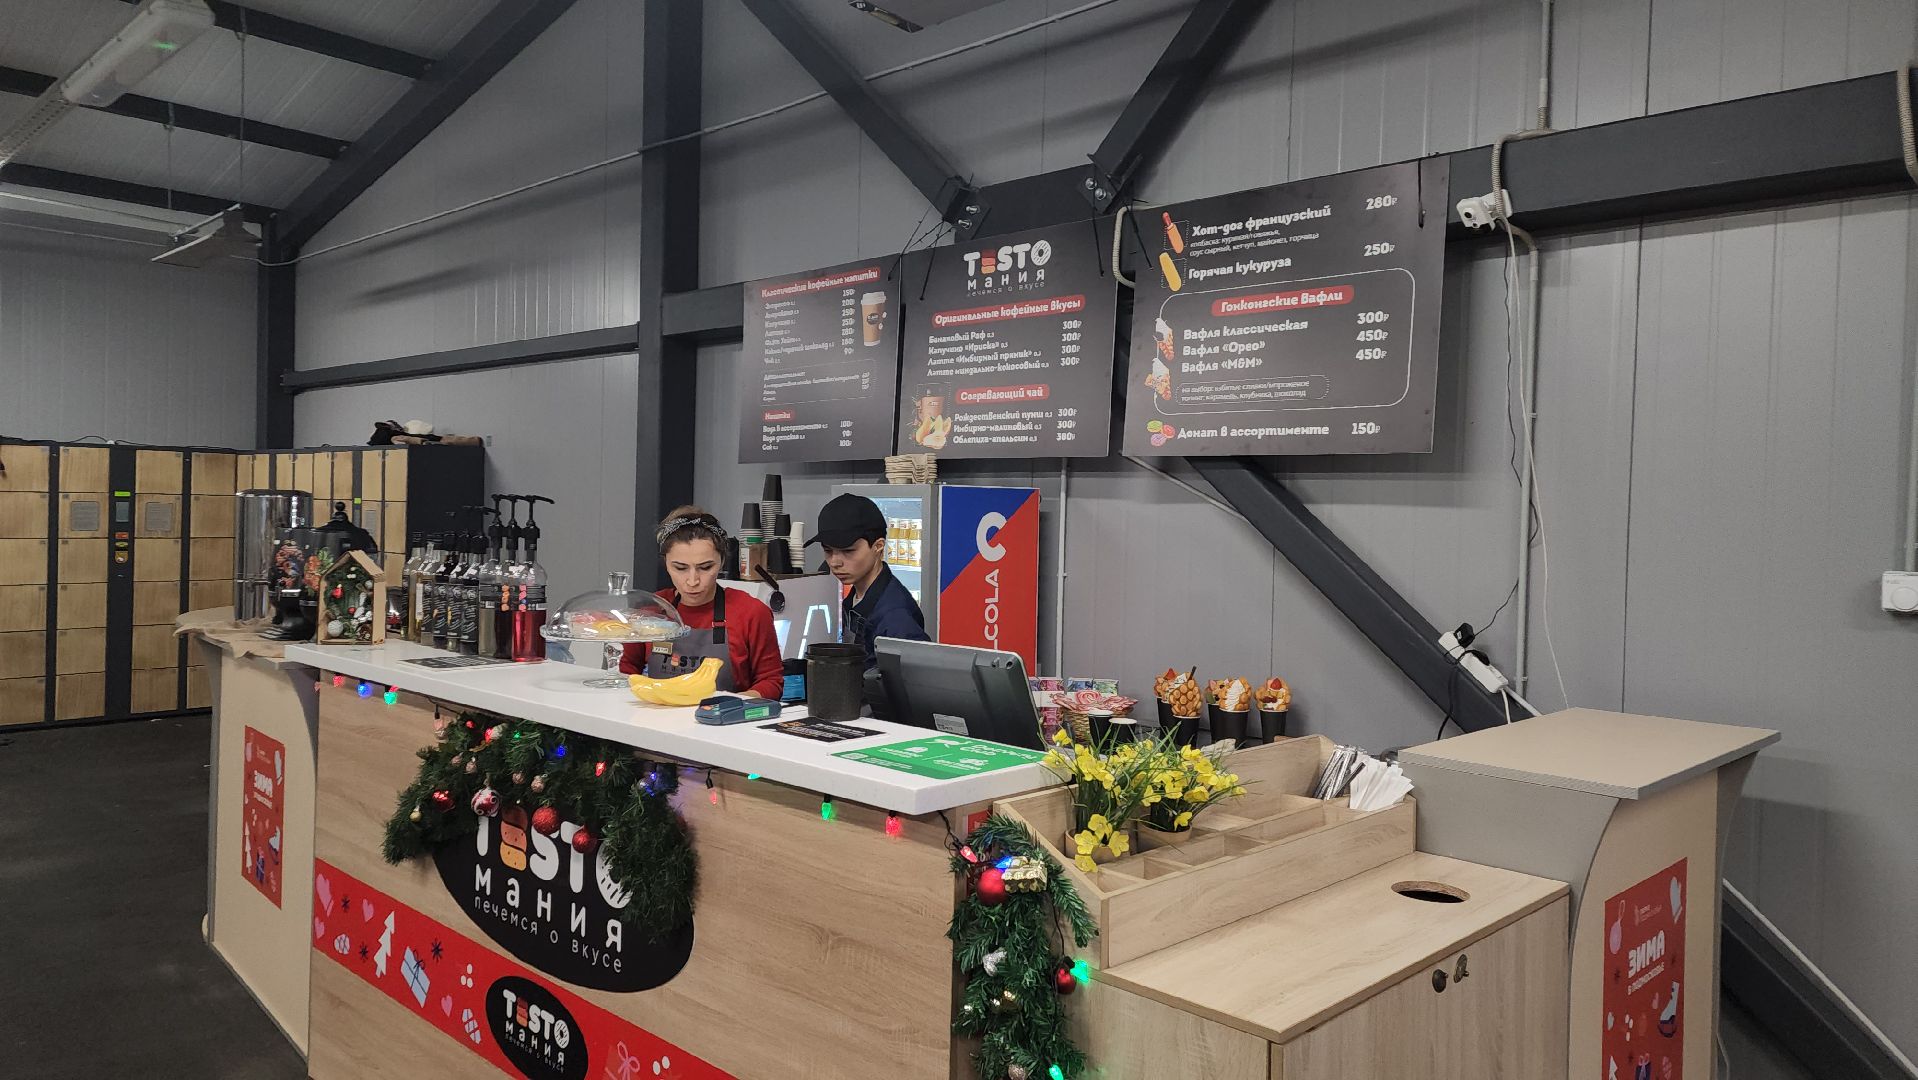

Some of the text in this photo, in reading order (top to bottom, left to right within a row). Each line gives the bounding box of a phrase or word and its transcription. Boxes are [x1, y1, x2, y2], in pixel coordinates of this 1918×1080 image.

[1191, 221, 1244, 237] Хот-дог
[1245, 205, 1332, 232] французский
[1188, 265, 1234, 281] Горячая
[1235, 255, 1292, 275] кукуруза
[807, 277, 844, 291] кофейные
[844, 269, 878, 283] напитки
[1220, 290, 1343, 313] Гонконгские вафли
[935, 299, 1081, 327] Оригинальные кофейные вкусы
[928, 333, 970, 344] Банановый
[970, 330, 986, 341] Раф
[1183, 328, 1221, 343] Вафля
[1223, 319, 1308, 337] классическая
[928, 346, 964, 356] Капучино
[964, 340, 1000, 353] «Ириска»
[1182, 344, 1220, 358] Вафля
[1222, 339, 1266, 355] «Орео»
[927, 357, 955, 366] Латте
[955, 352, 999, 364] «Имбирный
[1181, 360, 1219, 375] Вафля
[926, 368, 954, 377] Латте
[954, 360, 1041, 376] миндально-кокосовый
[960, 387, 1025, 403] Согревающий
[1026, 386, 1043, 397] чай
[954, 411, 1020, 423] Рождественский
[1021, 411, 1044, 421] пунш
[953, 421, 1034, 434] Имбирно-малиновый
[1177, 426, 1218, 440] Донат
[1220, 425, 1228, 437] в
[1230, 424, 1330, 440] ассортименте
[952, 434, 1028, 444] Облепиха-апельсин
[474, 896, 622, 973] печемся о вкусе
[1628, 930, 1665, 979] ЗИМА
